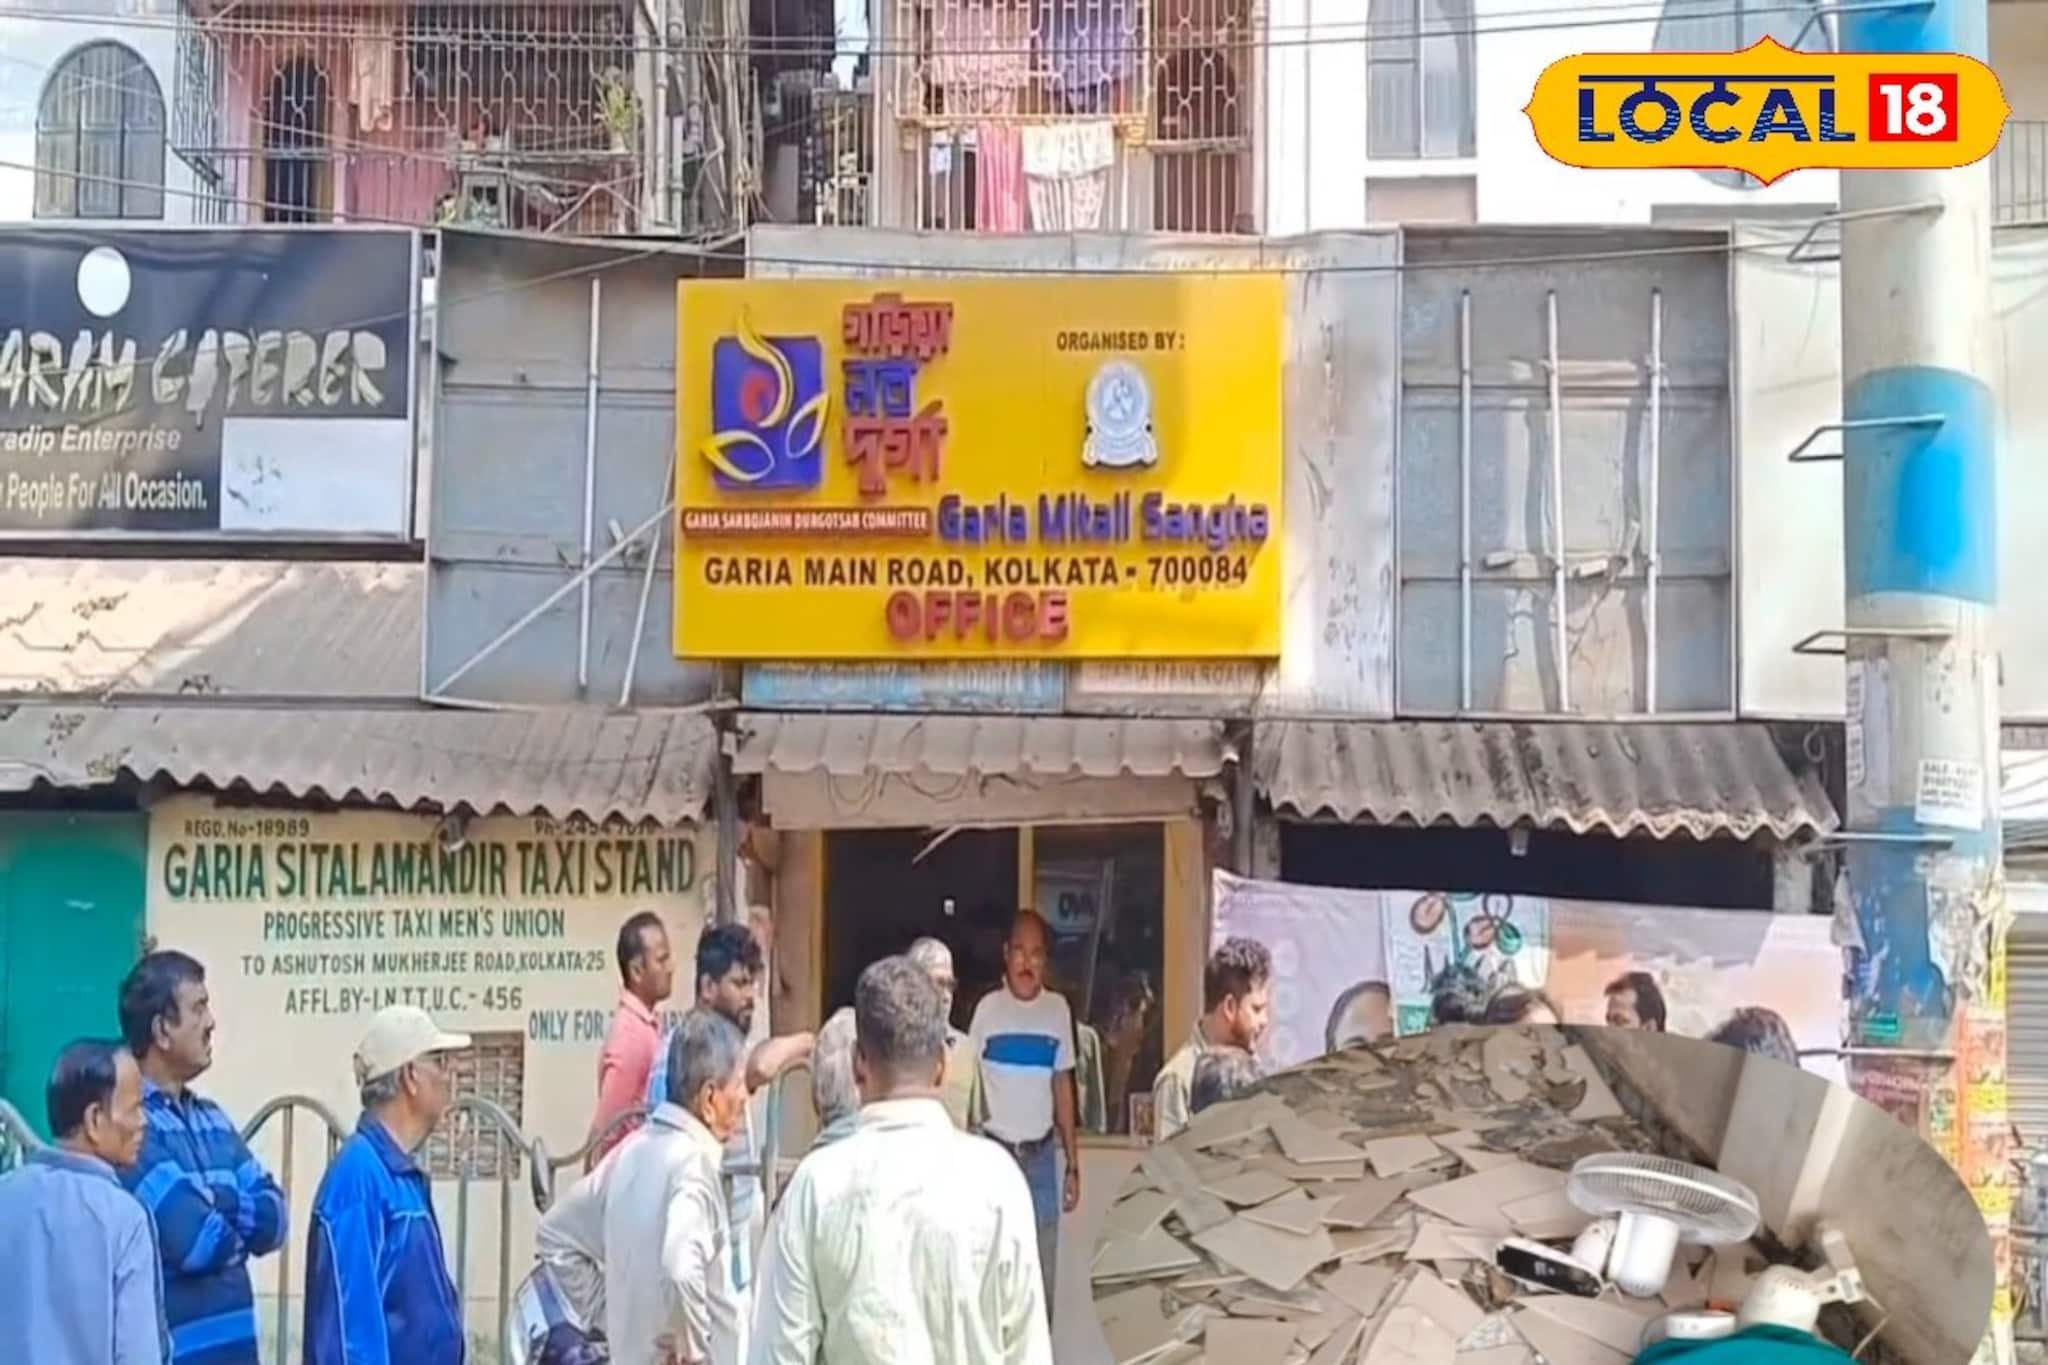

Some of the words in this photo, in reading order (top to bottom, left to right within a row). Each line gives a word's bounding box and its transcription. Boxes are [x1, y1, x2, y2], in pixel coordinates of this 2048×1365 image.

[1057, 332, 1148, 350] ORGANISED
[60, 422, 181, 457] Enterprise
[7, 472, 64, 518] People
[68, 472, 97, 509] For
[98, 472, 122, 509] All
[124, 471, 207, 509] Occasion.
[685, 511, 721, 529] GARIA
[862, 511, 927, 529] COMMITTEE
[937, 491, 1027, 542] Garia
[1038, 490, 1131, 542] Mitali
[1140, 491, 1269, 551] Sangha
[705, 556, 792, 585] GARIA
[804, 557, 877, 585] MAIN
[888, 557, 974, 588] ROAD,
[985, 556, 1119, 585] KOLKATA
[1147, 556, 1249, 585] 700084
[886, 590, 1068, 642] OFFICE
[164, 843, 266, 897] GARIA
[276, 841, 507, 897] SITALAMANDIR
[516, 839, 586, 896] TAXI
[594, 838, 696, 893] STAND
[264, 910, 385, 940] PROGRESSIVE
[393, 909, 433, 939] TAXI
[439, 907, 494, 938] MEN'S
[502, 908, 565, 938] UNION
[241, 955, 265, 976] TO
[272, 954, 365, 975] ASHUTOSH
[372, 952, 467, 974] MUKHERJEE
[529, 1010, 569, 1041] ONLY
[573, 1010, 605, 1041] FOR
